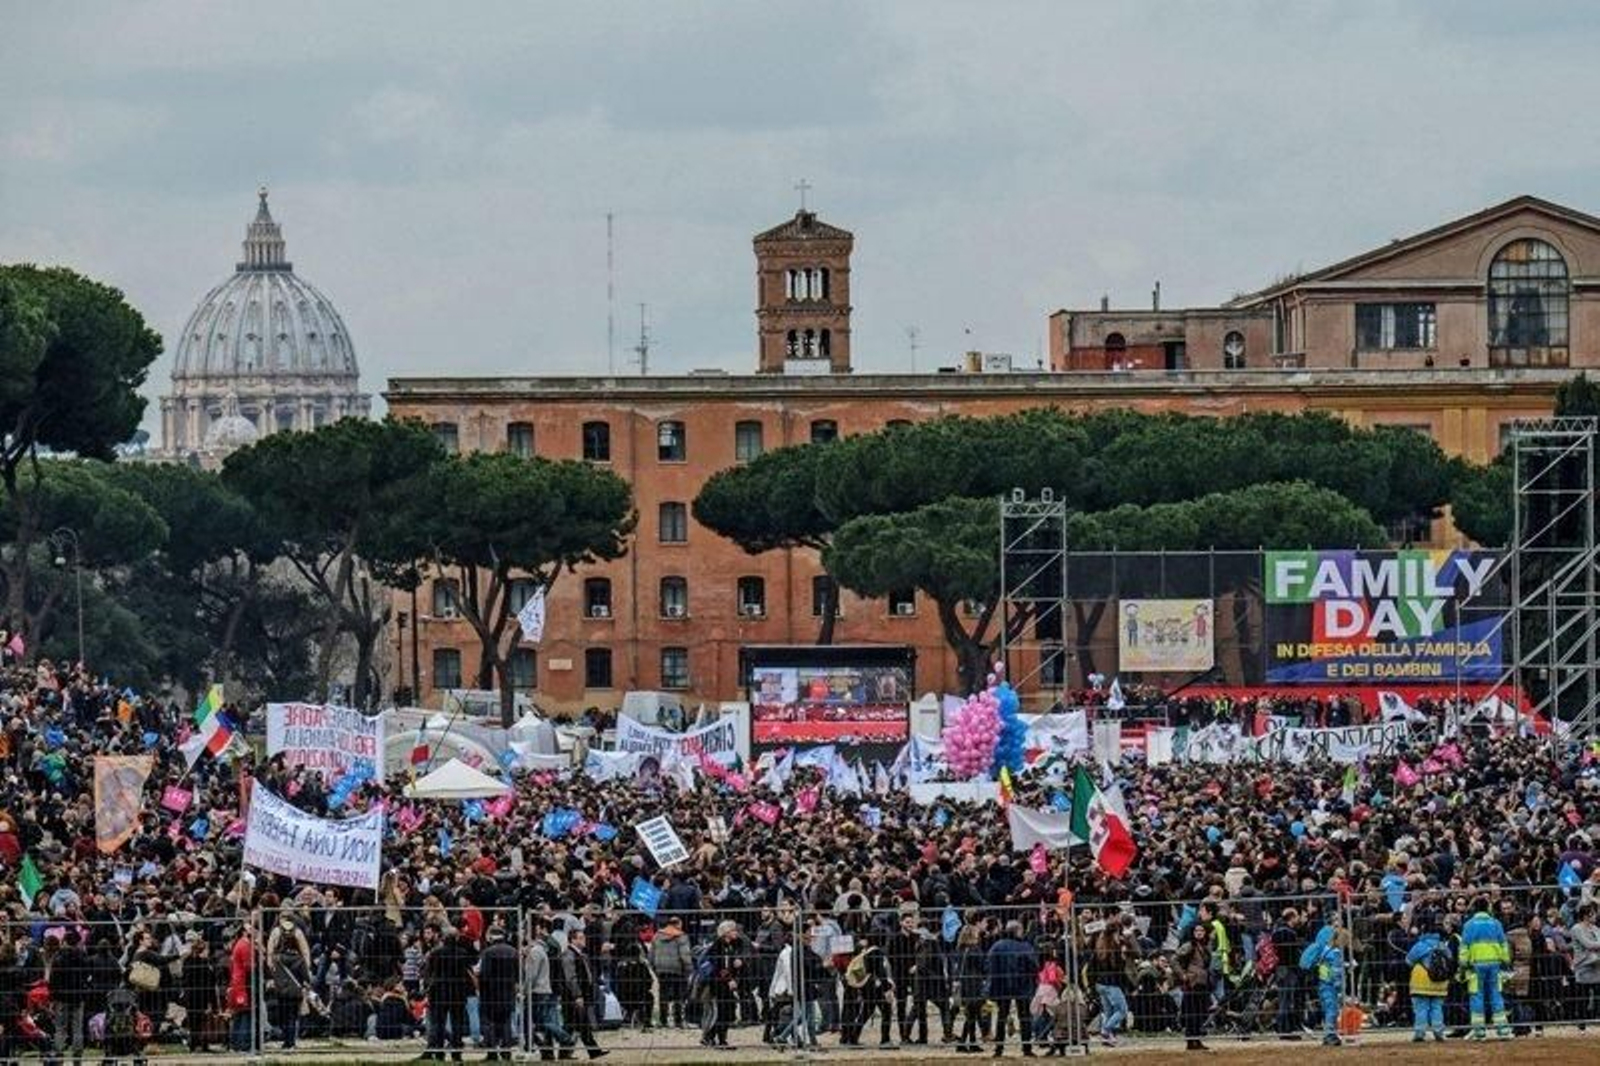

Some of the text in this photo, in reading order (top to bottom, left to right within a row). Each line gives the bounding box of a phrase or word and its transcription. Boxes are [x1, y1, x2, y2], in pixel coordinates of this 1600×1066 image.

[1275, 558, 1495, 597] FAMILY
[1325, 599, 1447, 638] DAY
[1277, 643, 1493, 658] IN DIFESA DELLA FAMIGLIA
[1327, 662, 1442, 677] E DEI BAMBINI
